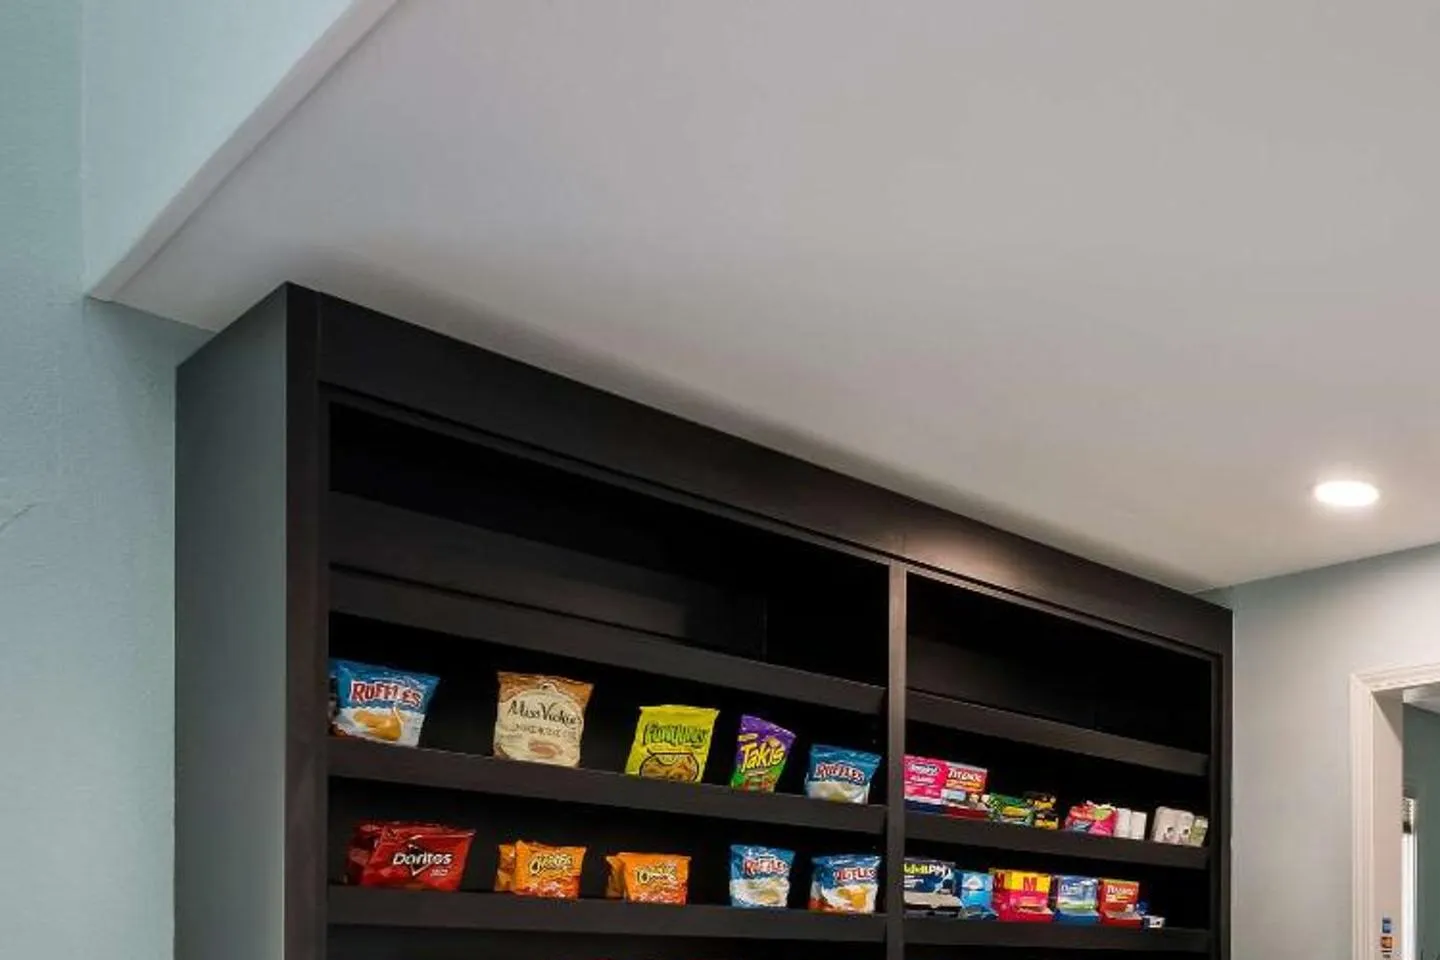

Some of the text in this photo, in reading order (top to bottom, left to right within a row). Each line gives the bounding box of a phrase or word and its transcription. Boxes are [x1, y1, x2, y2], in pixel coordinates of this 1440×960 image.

[351, 679, 423, 707] RUFFLES
[507, 700, 539, 718] Miss
[740, 741, 785, 770] Takis
[393, 851, 453, 867] Doritos
